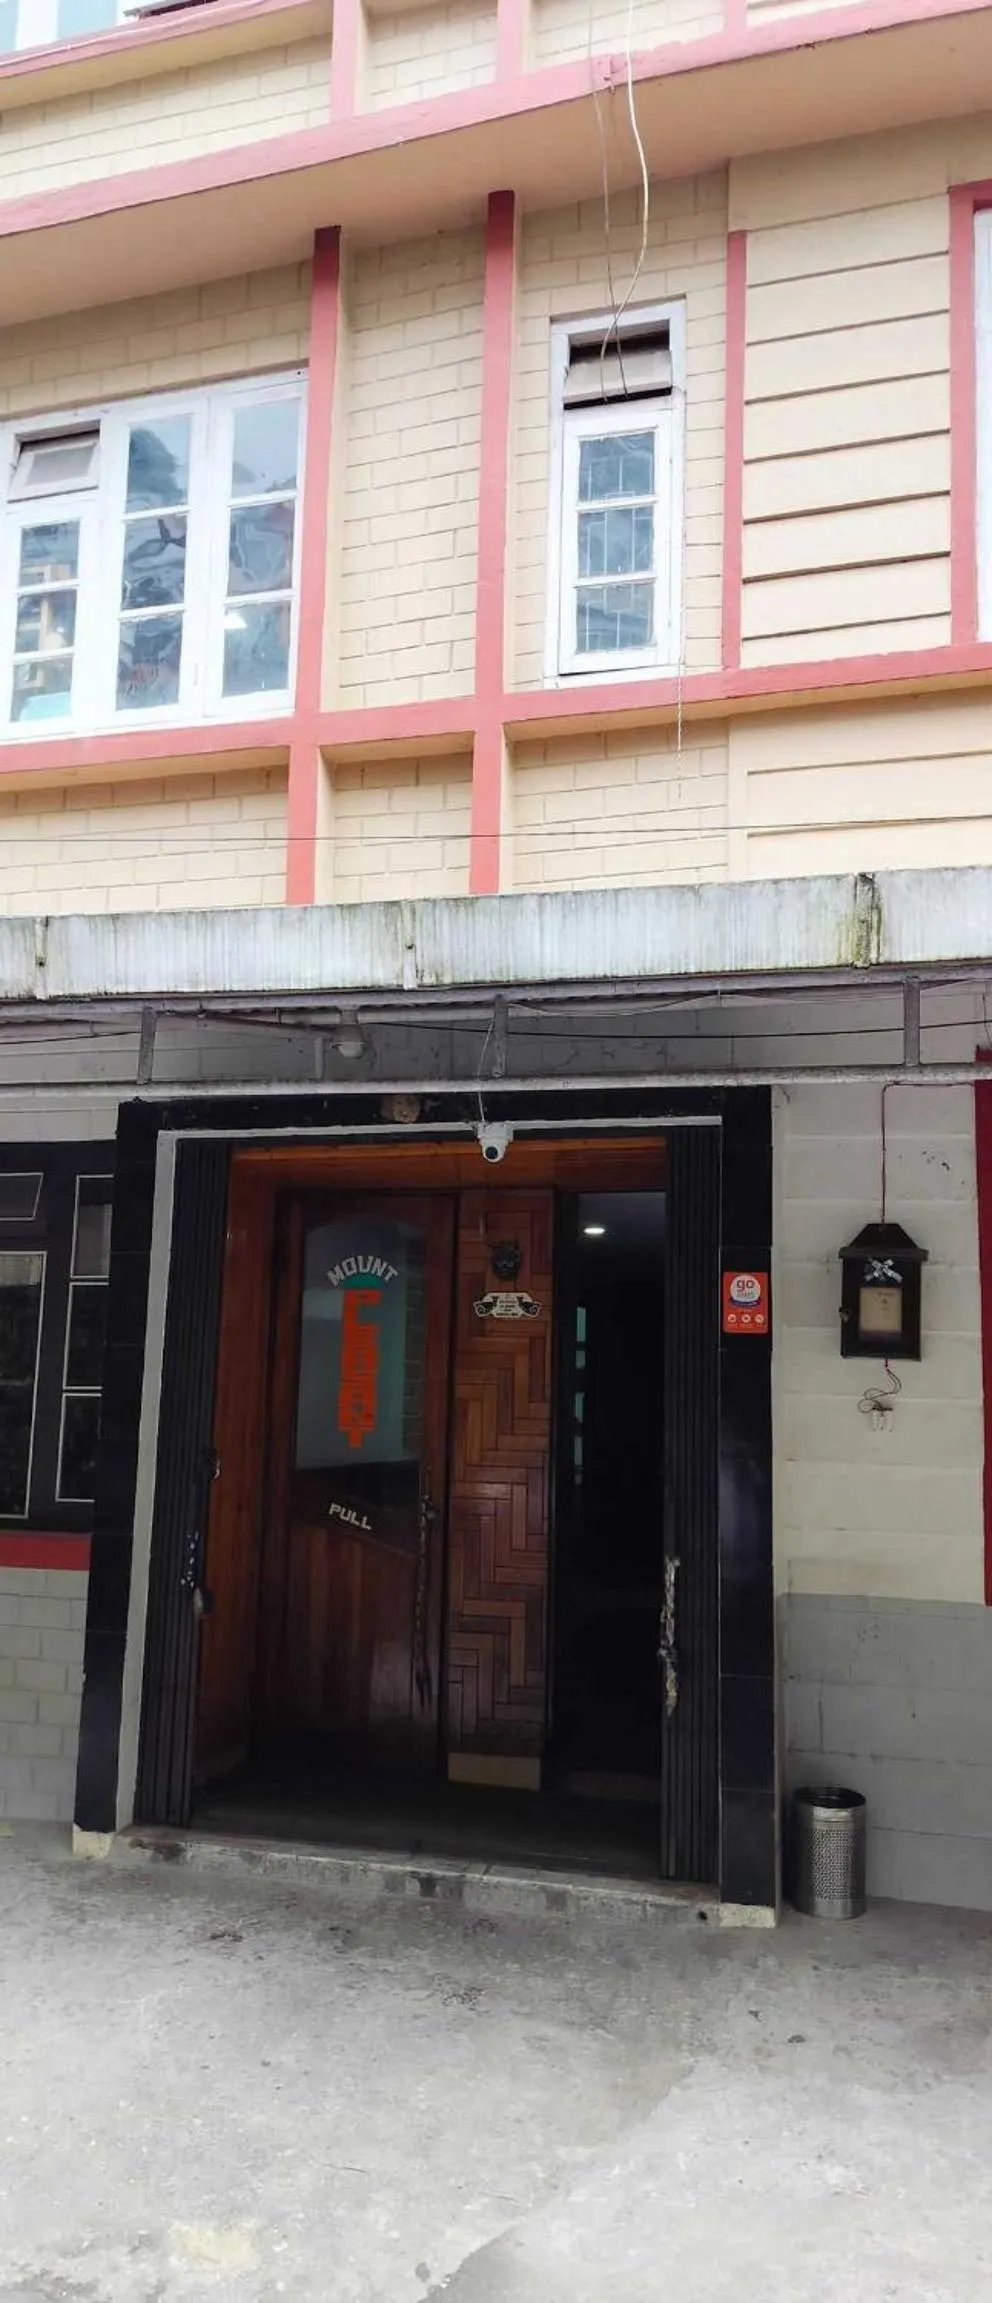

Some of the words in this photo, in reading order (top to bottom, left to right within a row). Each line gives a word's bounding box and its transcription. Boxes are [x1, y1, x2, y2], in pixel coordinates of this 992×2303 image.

[327, 1255, 399, 1286] MOUNT
[736, 1280, 755, 1291] go
[328, 1503, 372, 1530] PULL
